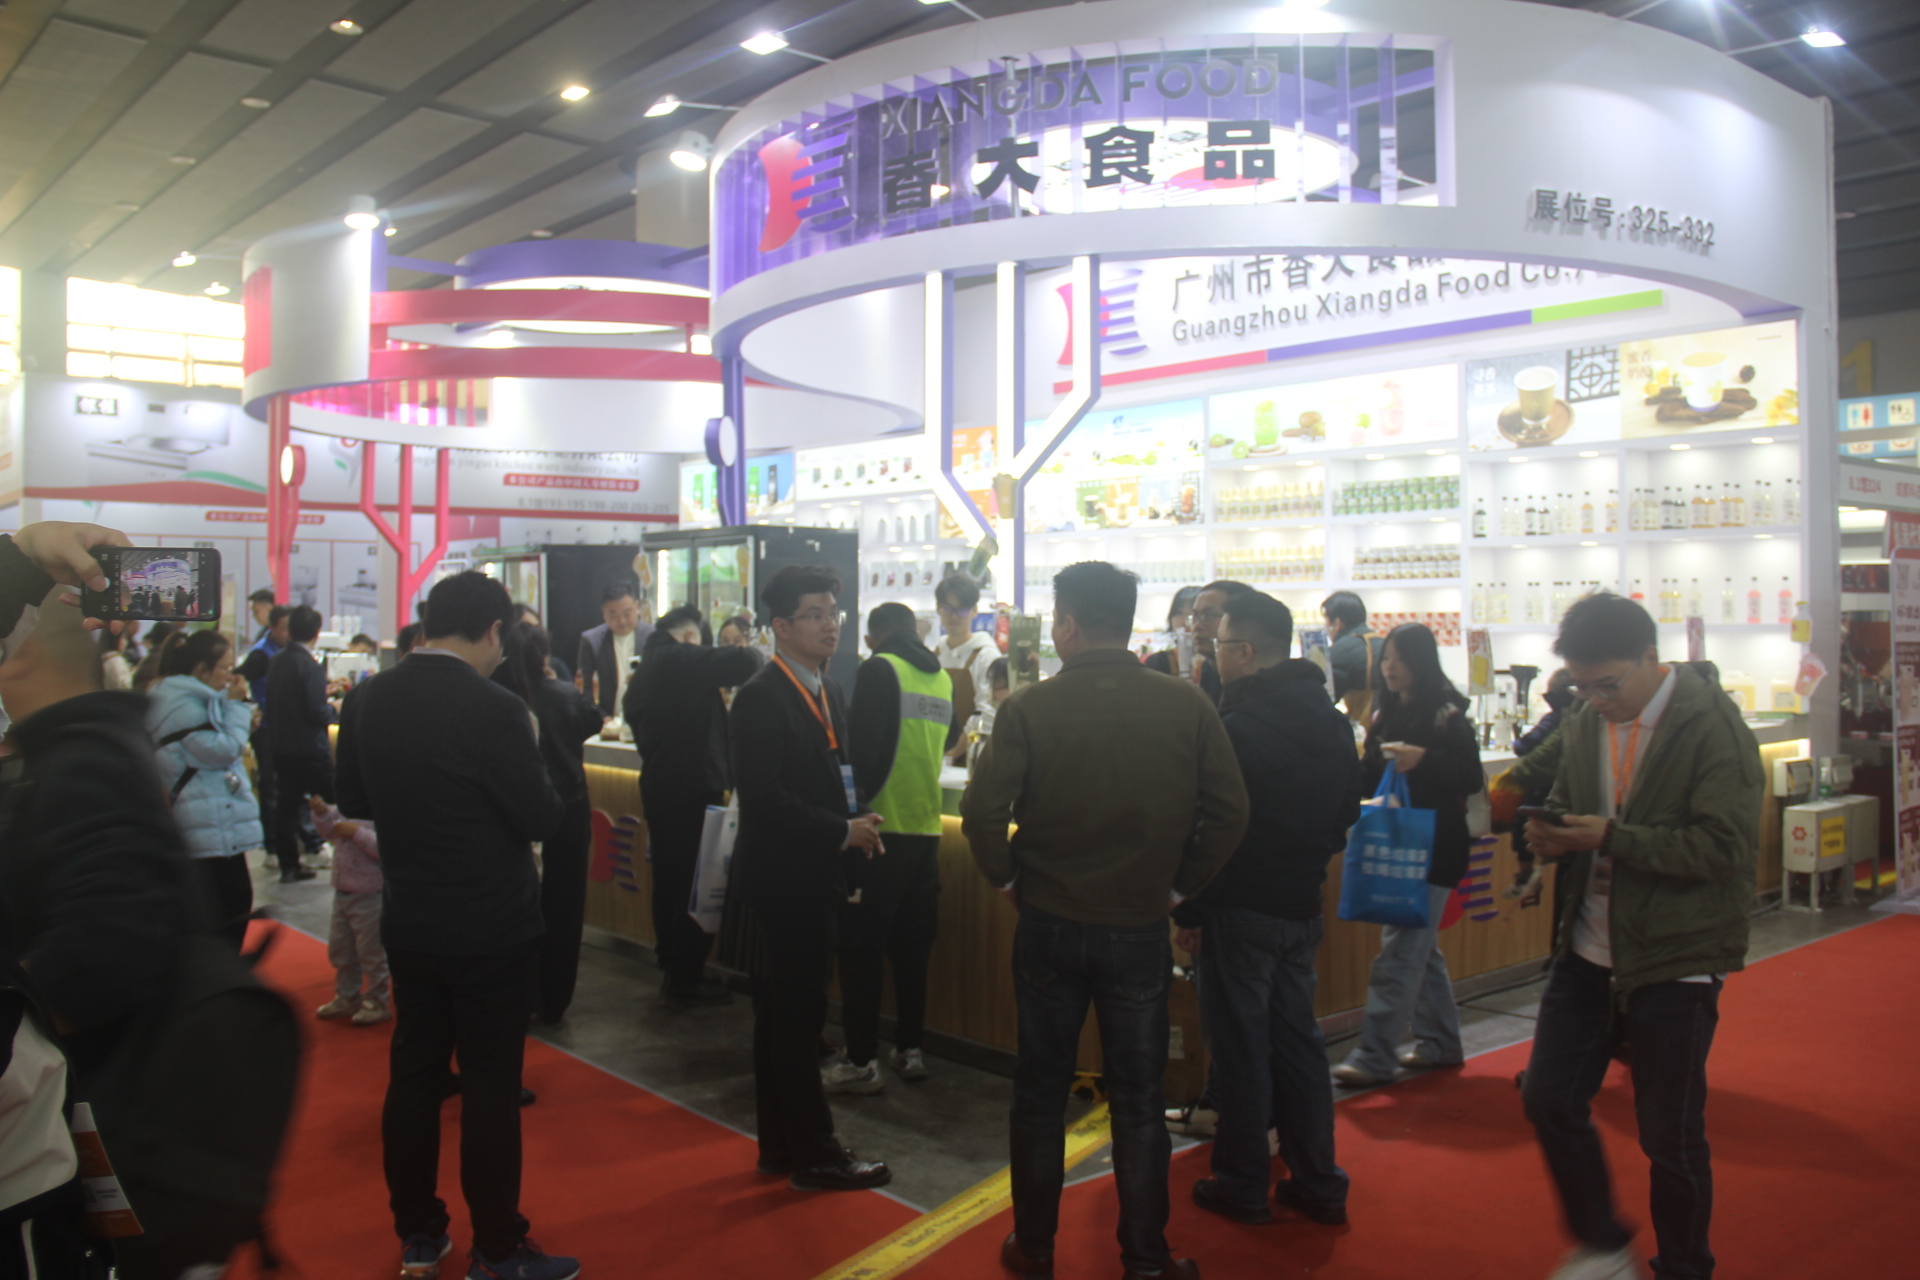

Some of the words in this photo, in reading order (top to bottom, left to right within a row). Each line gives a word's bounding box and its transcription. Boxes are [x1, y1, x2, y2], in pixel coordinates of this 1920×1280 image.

[882, 66, 1102, 139] XIANGDA
[1122, 55, 1279, 104] FOOD
[882, 120, 1276, 214] 香大食品
[1172, 303, 1307, 341] Guangzhou
[1316, 279, 1427, 318] Xiangda
[1437, 261, 1510, 298] Food
